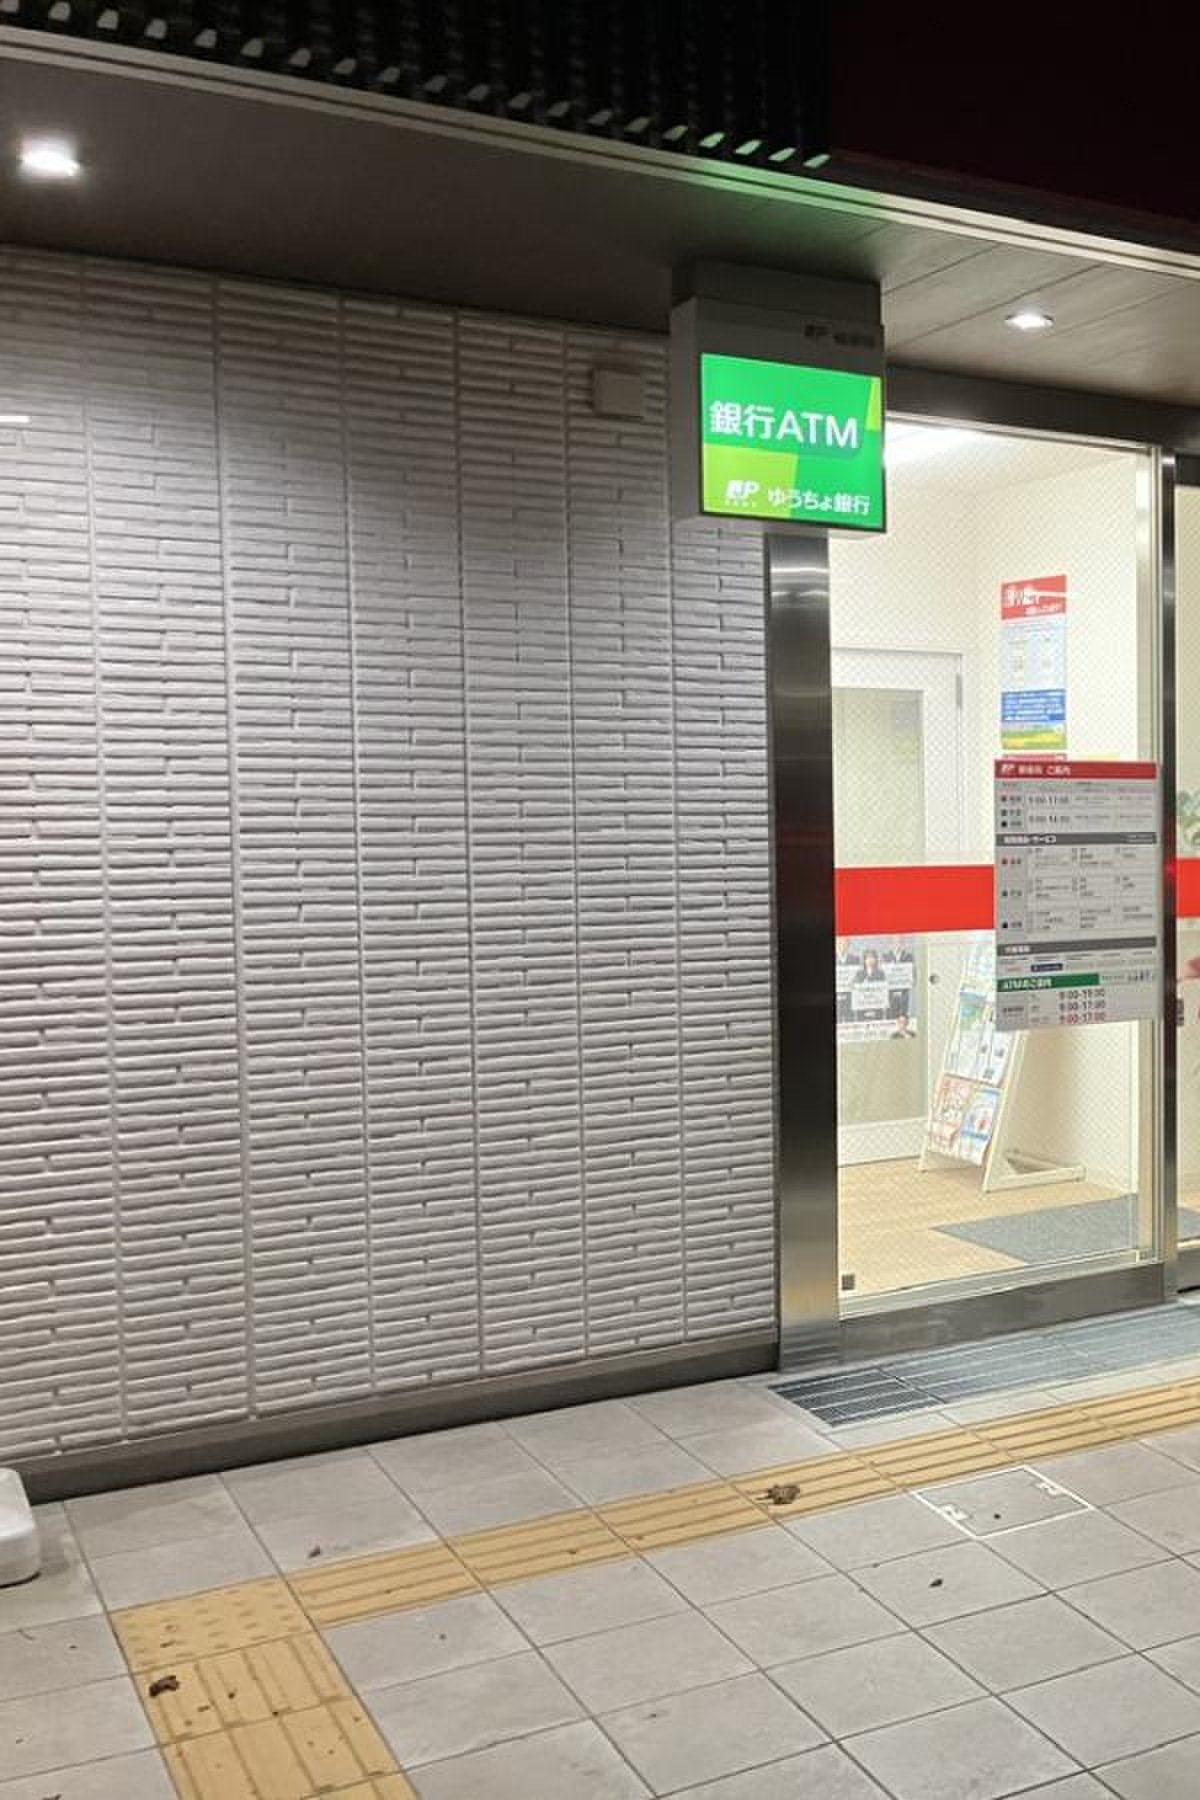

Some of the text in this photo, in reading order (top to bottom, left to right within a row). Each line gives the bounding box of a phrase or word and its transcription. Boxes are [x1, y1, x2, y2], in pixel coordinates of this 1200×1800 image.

[709, 400, 859, 448] 銀行ATM
[768, 488, 870, 515] ゆうちょ銀行
